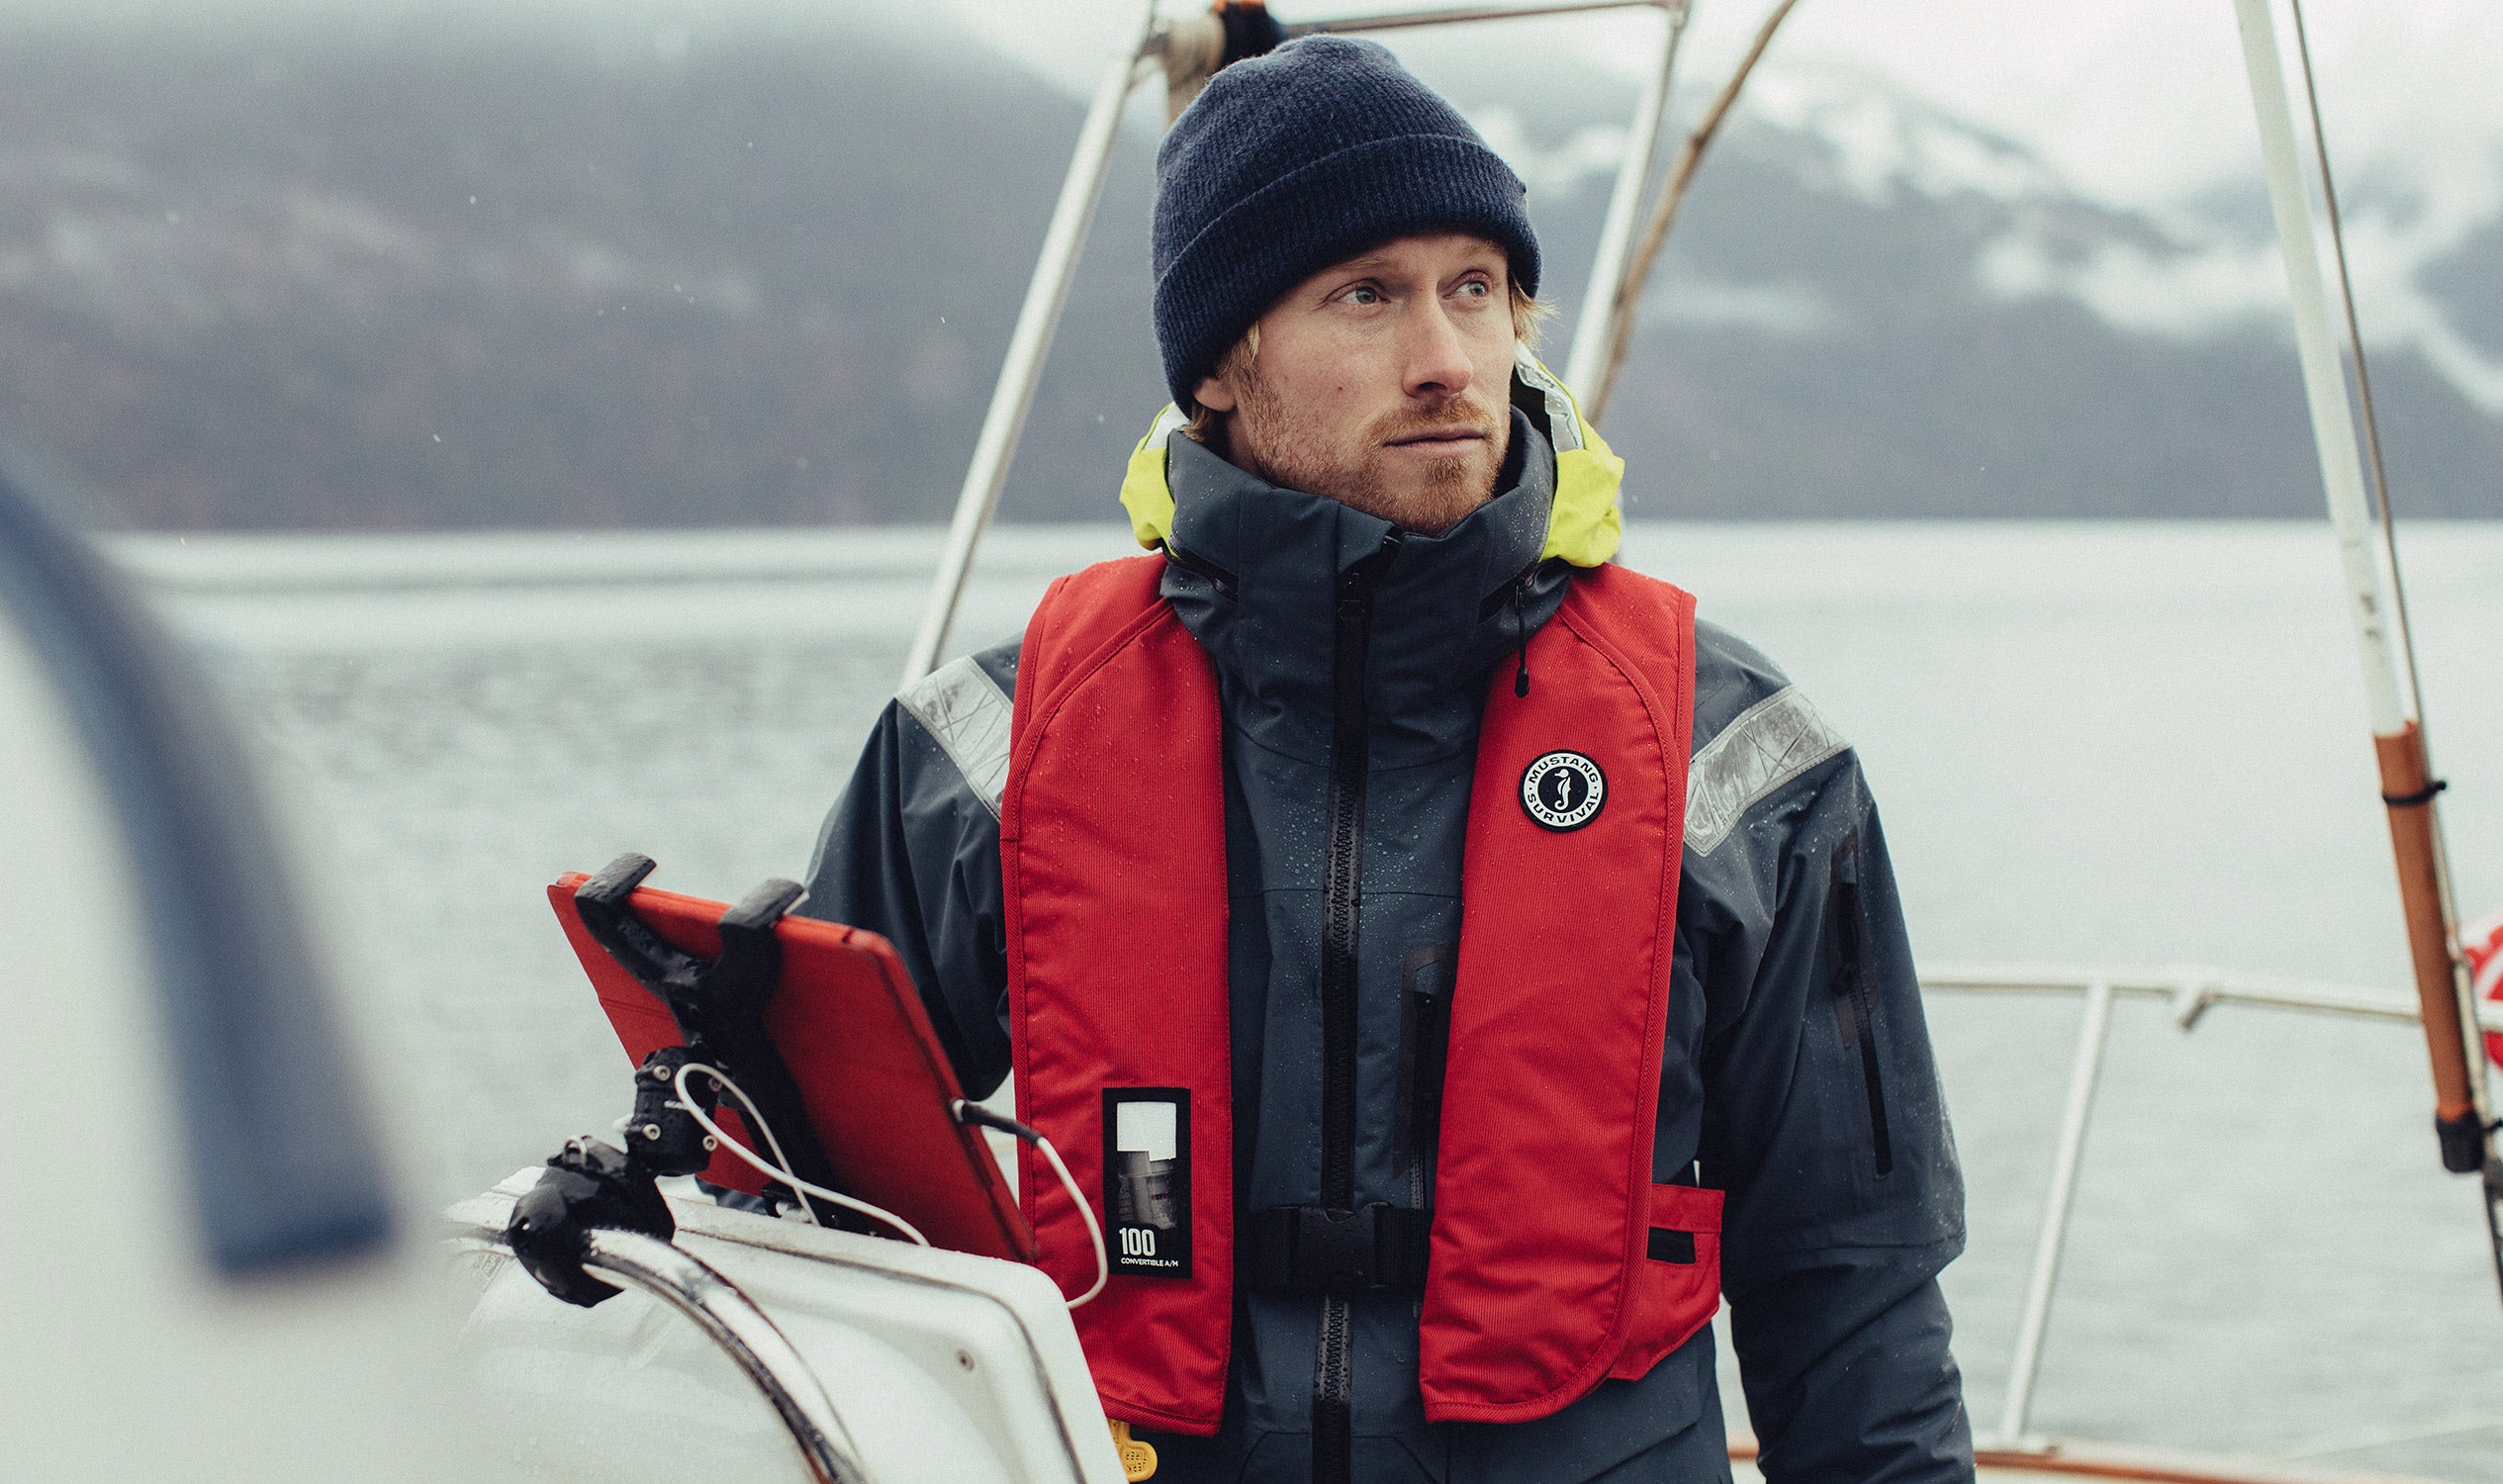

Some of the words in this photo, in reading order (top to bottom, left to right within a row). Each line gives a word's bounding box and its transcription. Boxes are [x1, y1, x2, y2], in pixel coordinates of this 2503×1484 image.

[1529, 757, 1599, 784] MUSTANG
[1528, 792, 1600, 823] SURVIVAL
[1119, 1227, 1156, 1256] 100
[1121, 1257, 1164, 1267] CONVERTIBLE
